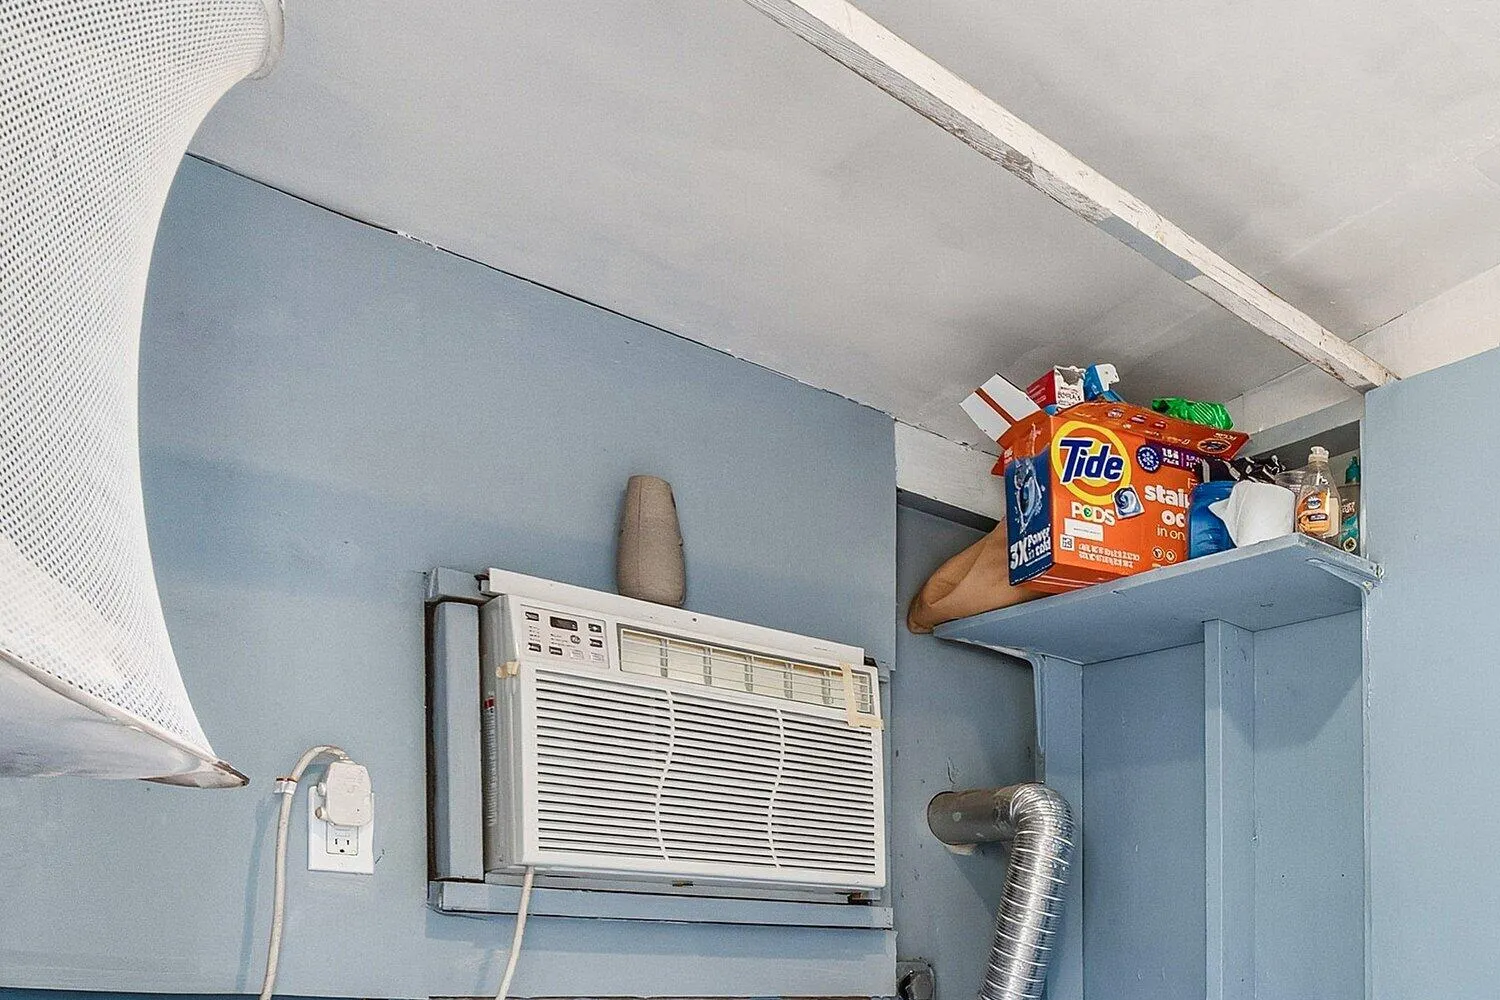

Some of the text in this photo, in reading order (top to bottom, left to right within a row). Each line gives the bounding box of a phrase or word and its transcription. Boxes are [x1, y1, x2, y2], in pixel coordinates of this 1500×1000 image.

[1059, 437, 1124, 485] Tide
[1071, 501, 1116, 526] PODS
[1157, 524, 1168, 538] in
[1009, 536, 1029, 570] 3X
